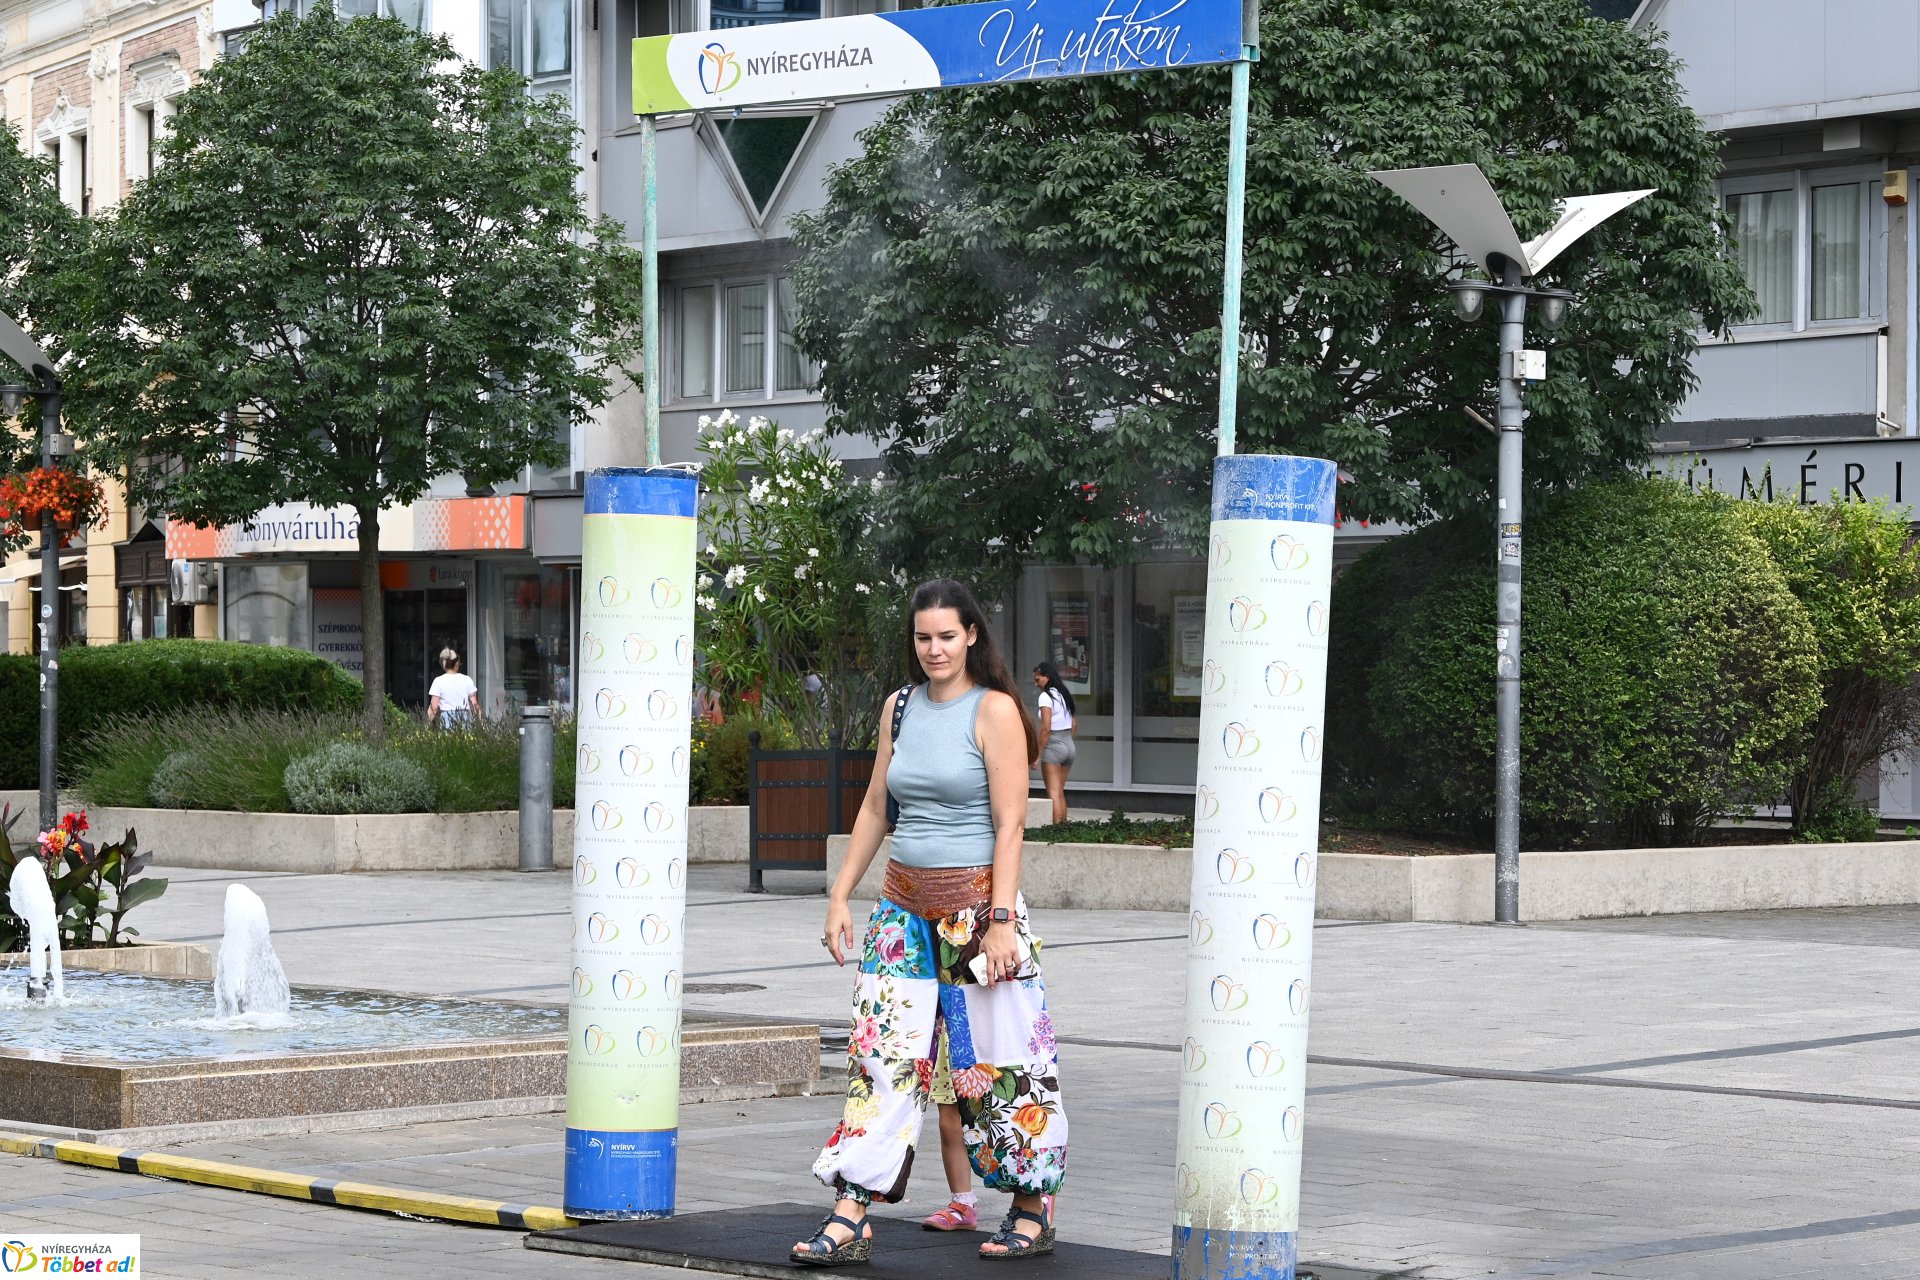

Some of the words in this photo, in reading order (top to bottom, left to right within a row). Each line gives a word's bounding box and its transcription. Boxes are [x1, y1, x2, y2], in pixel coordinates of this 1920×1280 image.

[1060, 0, 1191, 75] utakon
[747, 44, 874, 77] NYÍREGYHÁZA
[318, 641, 363, 652] GYEREKKÖ
